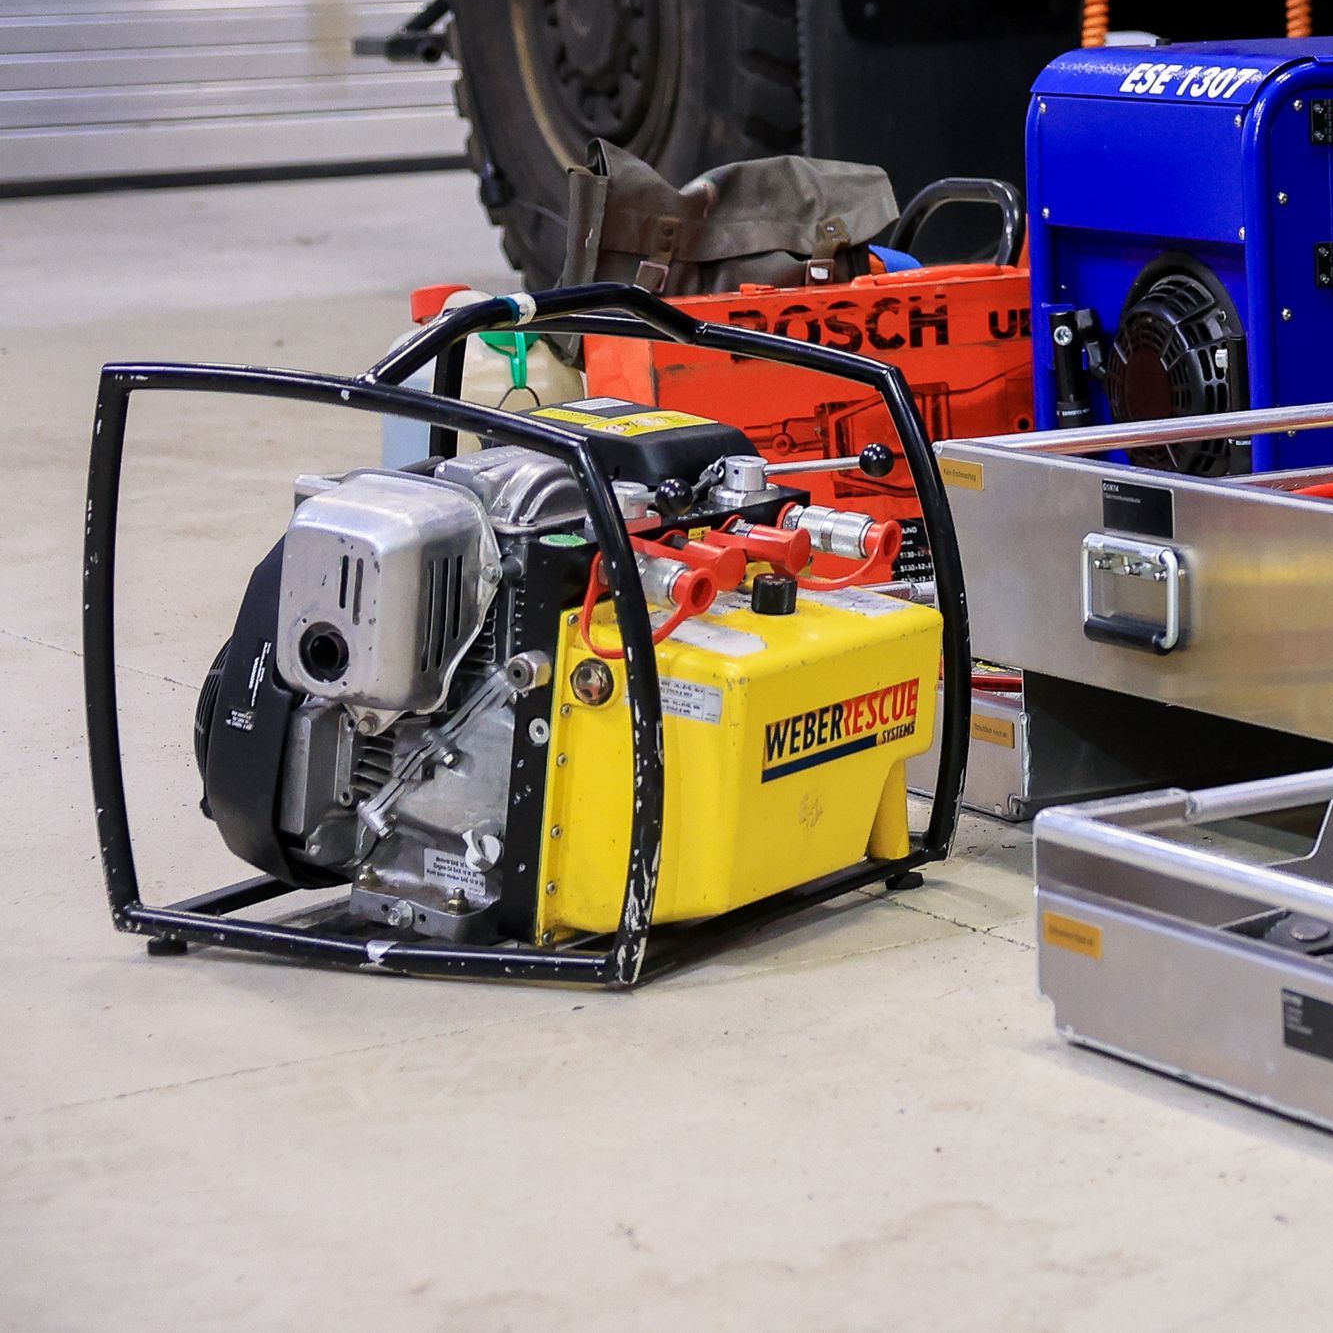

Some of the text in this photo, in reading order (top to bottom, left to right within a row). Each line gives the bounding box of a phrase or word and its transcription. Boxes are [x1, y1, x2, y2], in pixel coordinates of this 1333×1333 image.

[1119, 62, 1259, 99] ESE 1307
[881, 720, 915, 745] SYSTEMS
